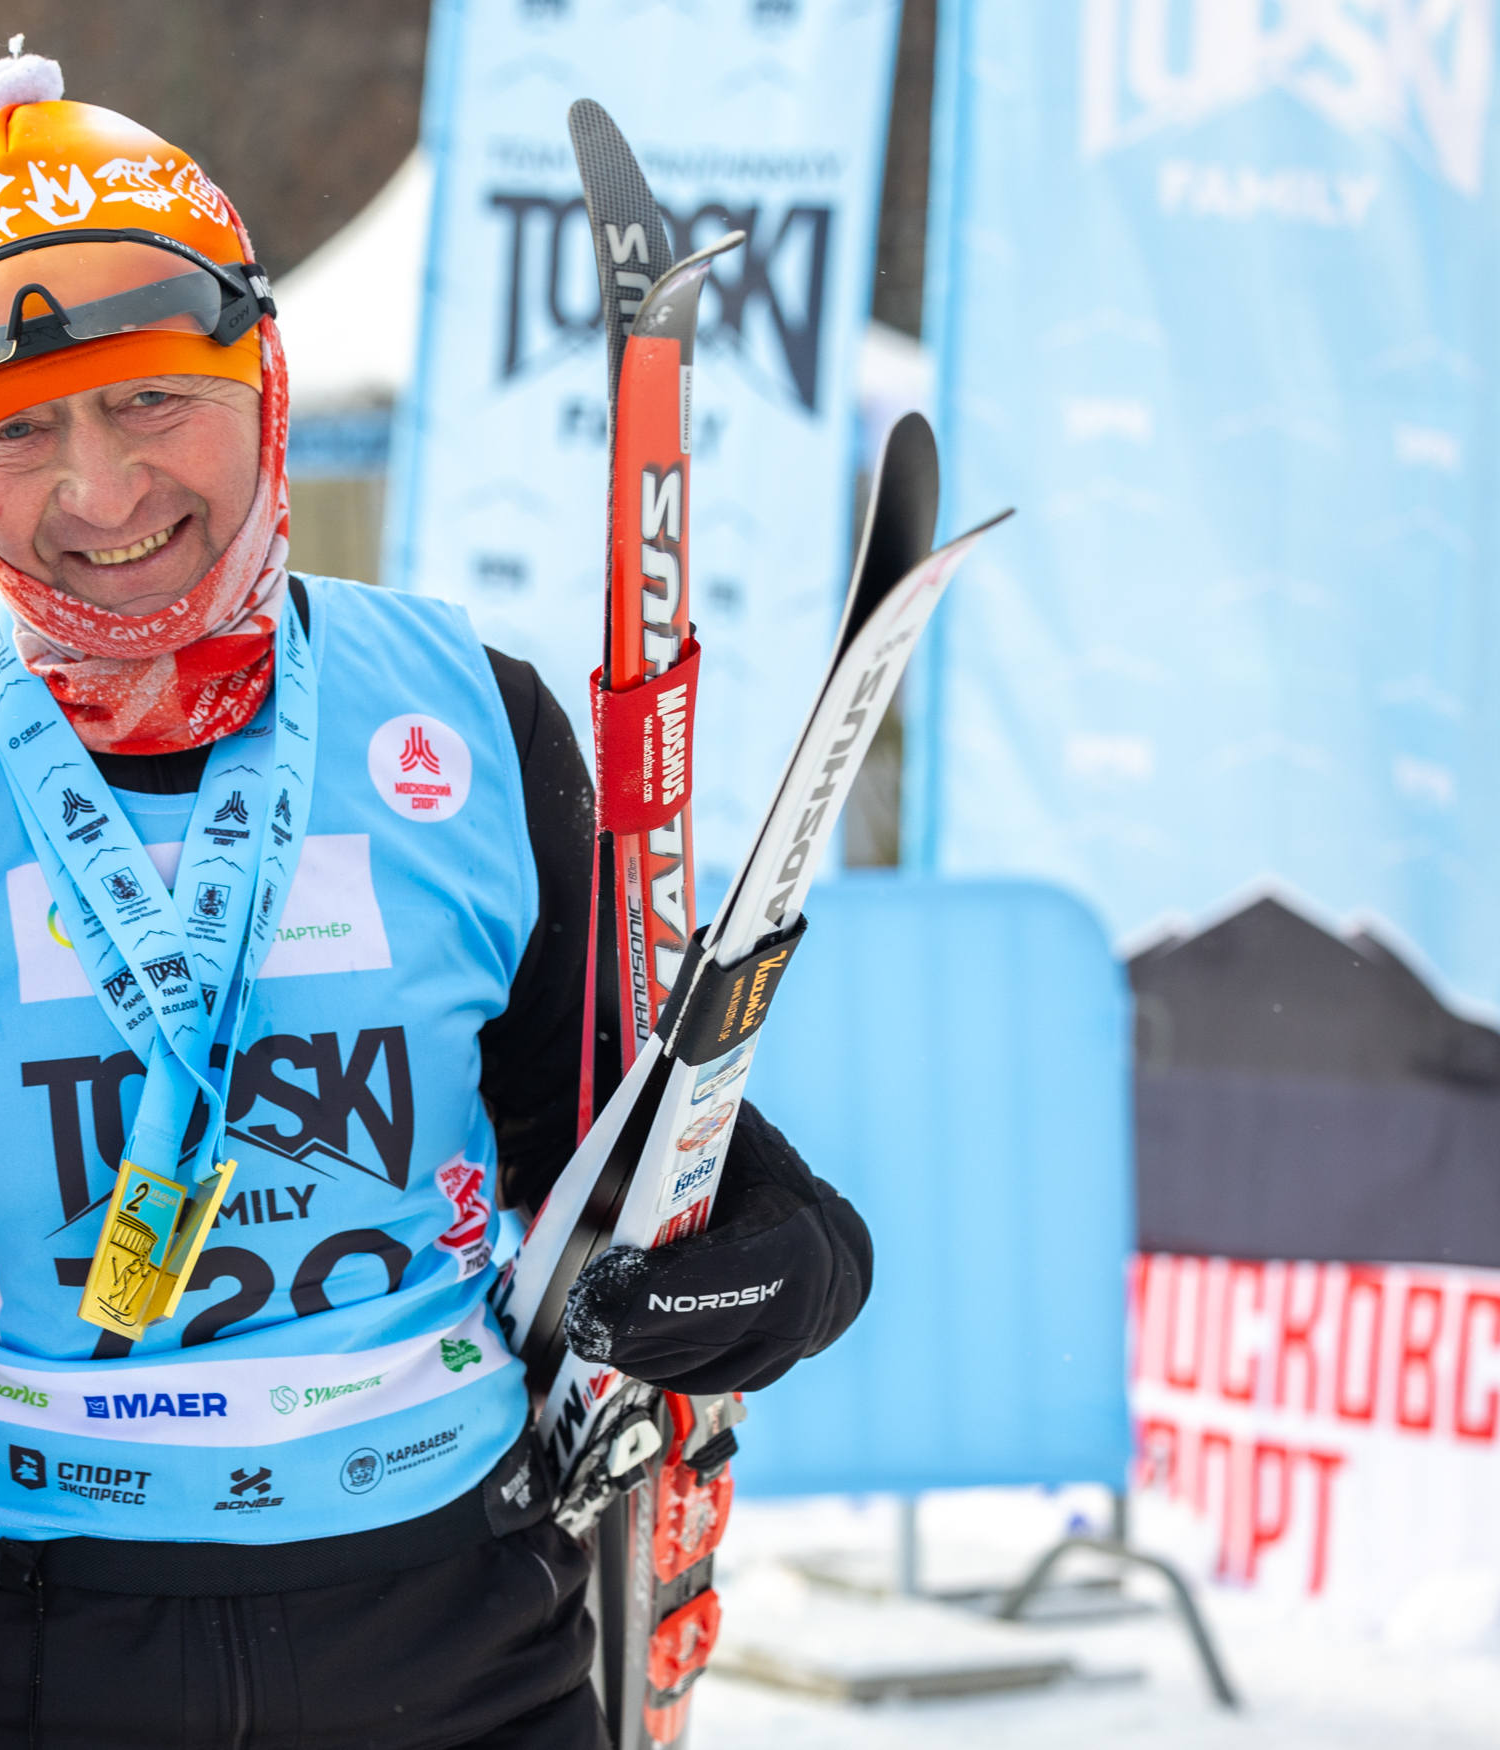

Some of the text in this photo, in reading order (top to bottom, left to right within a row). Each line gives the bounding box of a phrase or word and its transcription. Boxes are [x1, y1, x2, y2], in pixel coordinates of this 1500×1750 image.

[657, 683, 687, 805] MADSHUS
[762, 660, 889, 932] ADSHUS
[188, 1183, 317, 1231] MILY
[113, 1393, 227, 1419] MAER
[57, 1462, 152, 1490] СПОРТ
[58, 1481, 146, 1505] ЭКСПРЕСС
